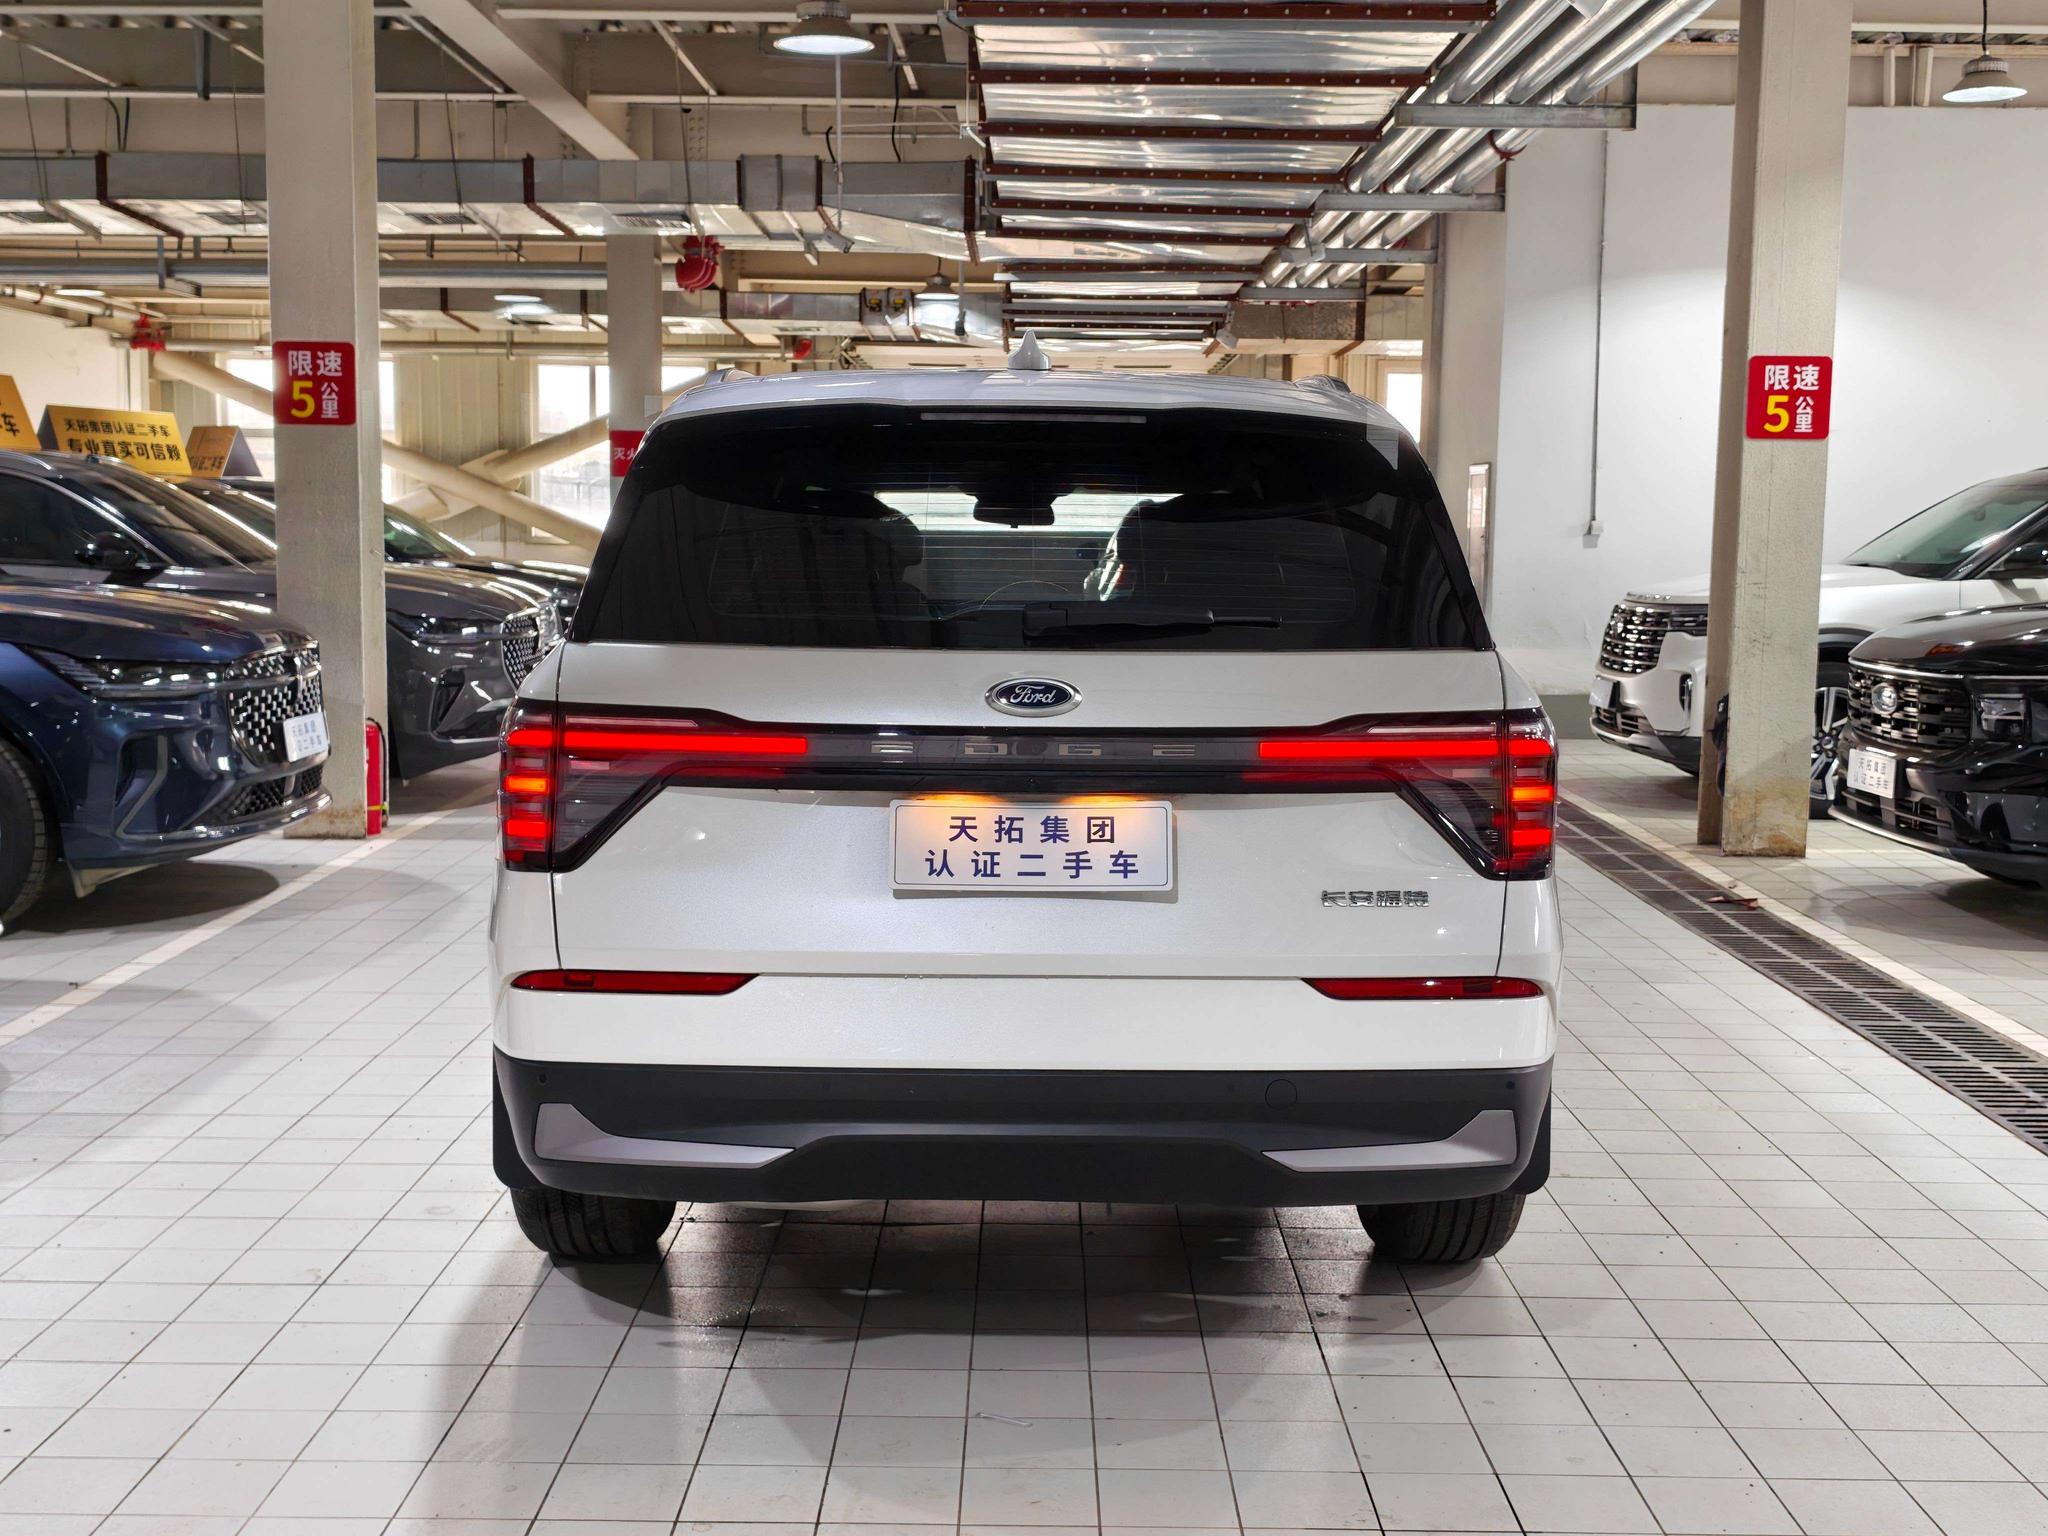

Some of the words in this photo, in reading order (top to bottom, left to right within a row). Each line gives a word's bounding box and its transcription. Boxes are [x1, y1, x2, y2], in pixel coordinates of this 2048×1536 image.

[287, 350, 343, 377] 限速
[1764, 364, 1820, 391] 限速
[290, 380, 315, 418] 5
[321, 382, 340, 419] 公里
[1763, 395, 1790, 433] 5
[1793, 396, 1815, 433] 公里
[1009, 683, 1057, 705] Ford
[871, 740, 1196, 756] EDGE
[948, 815, 1116, 844] 天拓集团
[925, 850, 1139, 879] 认证二手车
[1321, 890, 1429, 907] 长安福特
